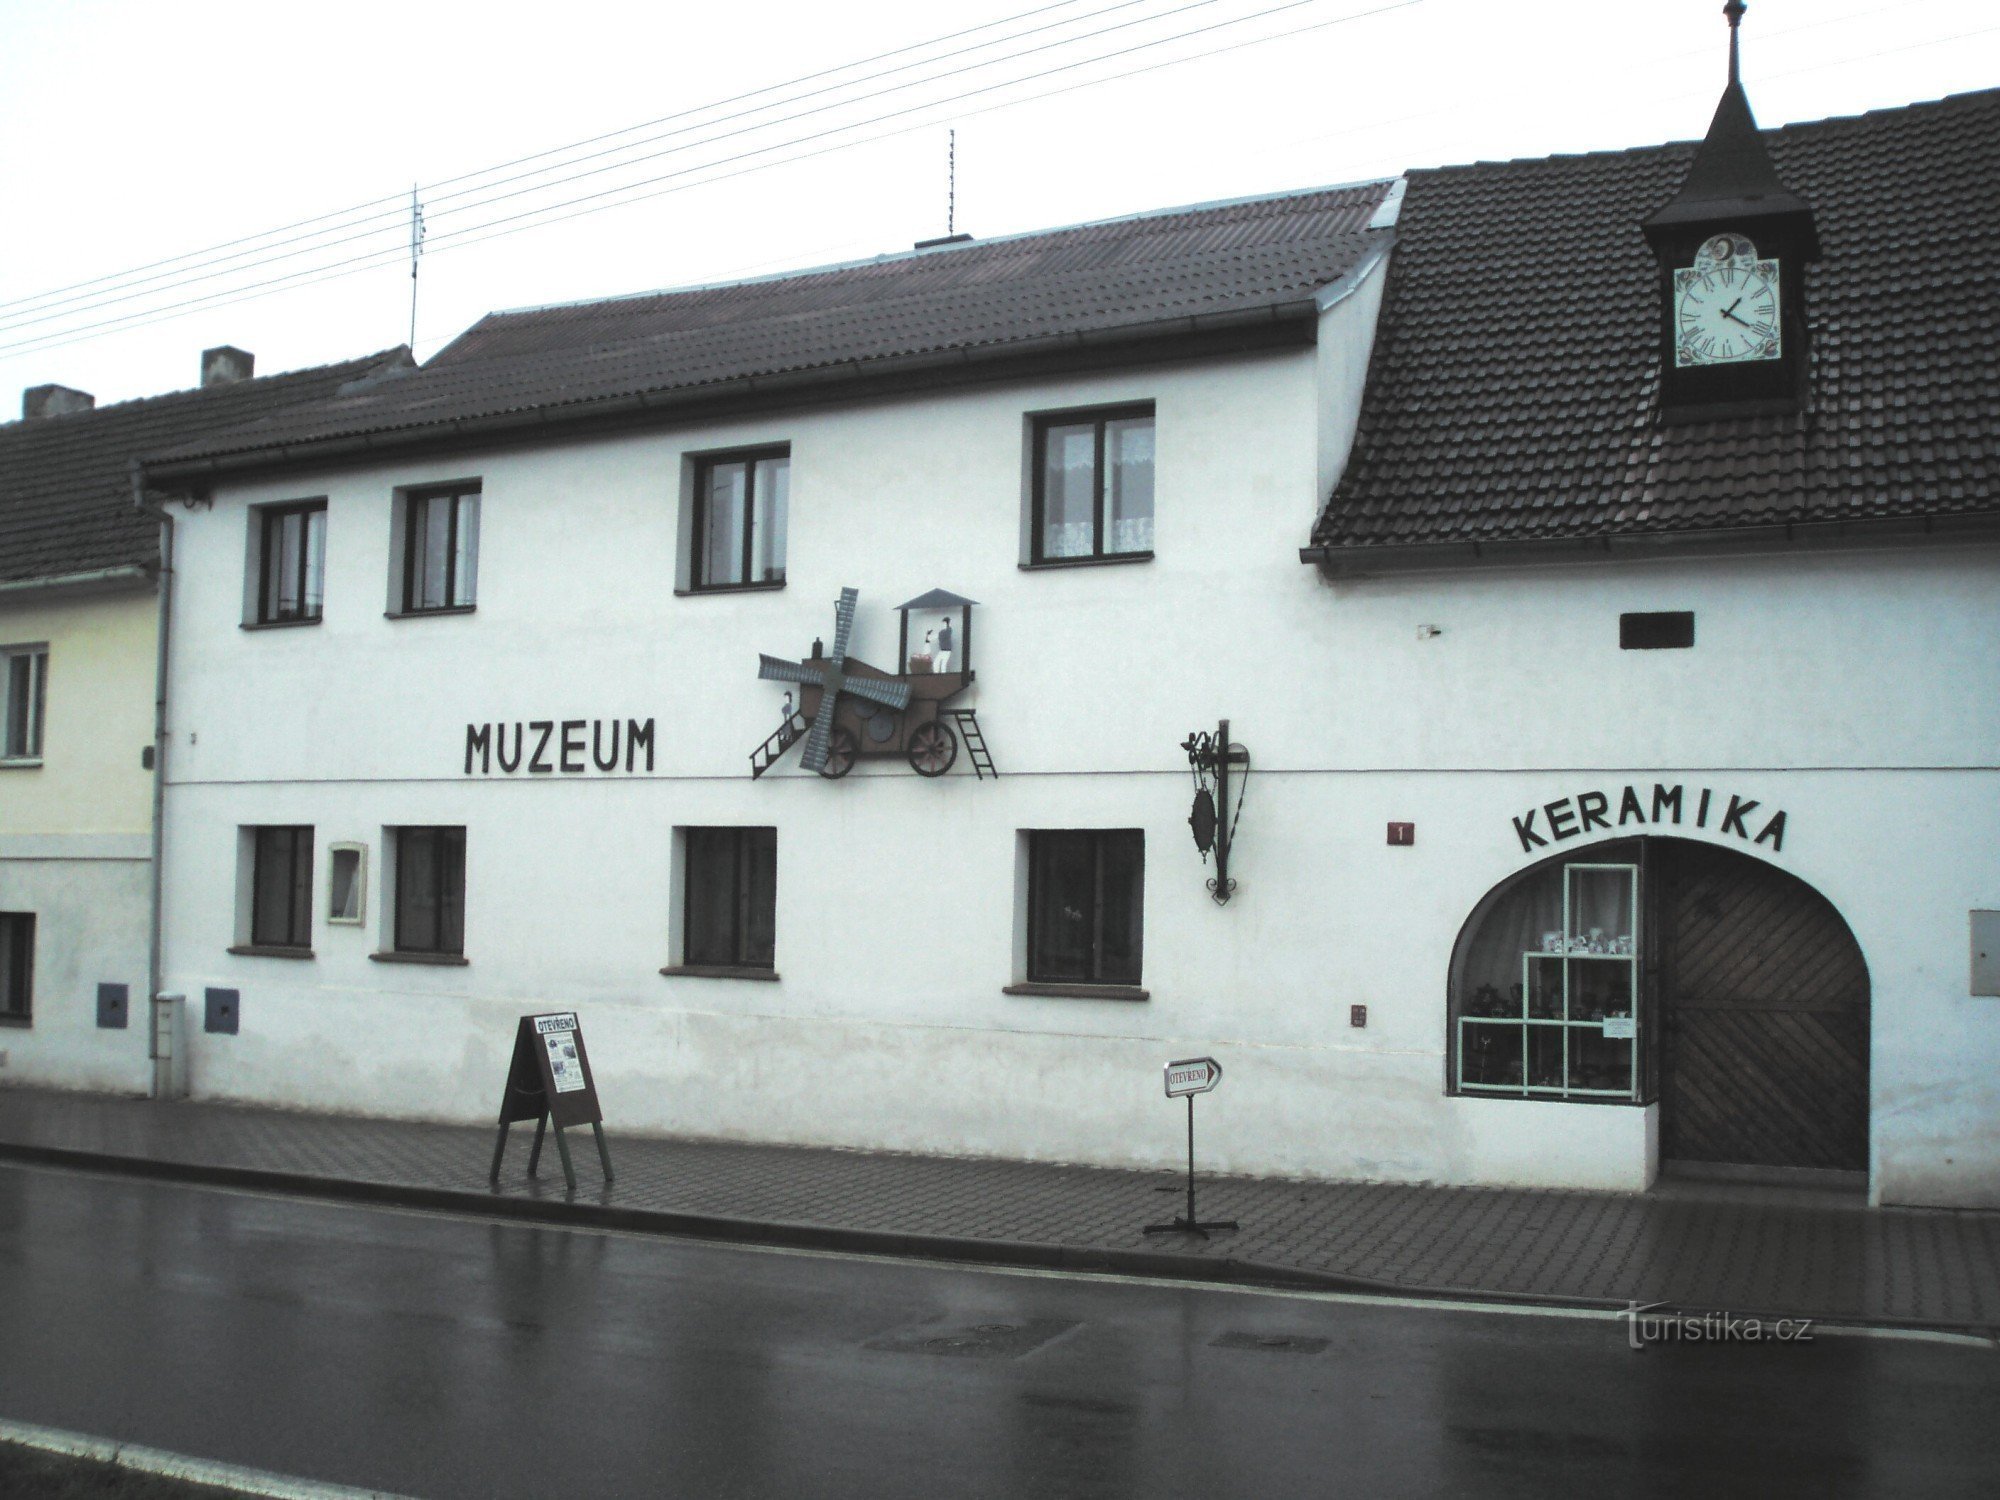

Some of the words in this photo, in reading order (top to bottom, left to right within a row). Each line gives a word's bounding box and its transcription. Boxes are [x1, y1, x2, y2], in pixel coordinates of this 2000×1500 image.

[464, 718, 655, 774] MUZEUM
[1512, 784, 1786, 852] KERAMIKA
[538, 1017, 574, 1031] OTEVŘENO
[1170, 1068, 1206, 1085] OTEVŘENO
